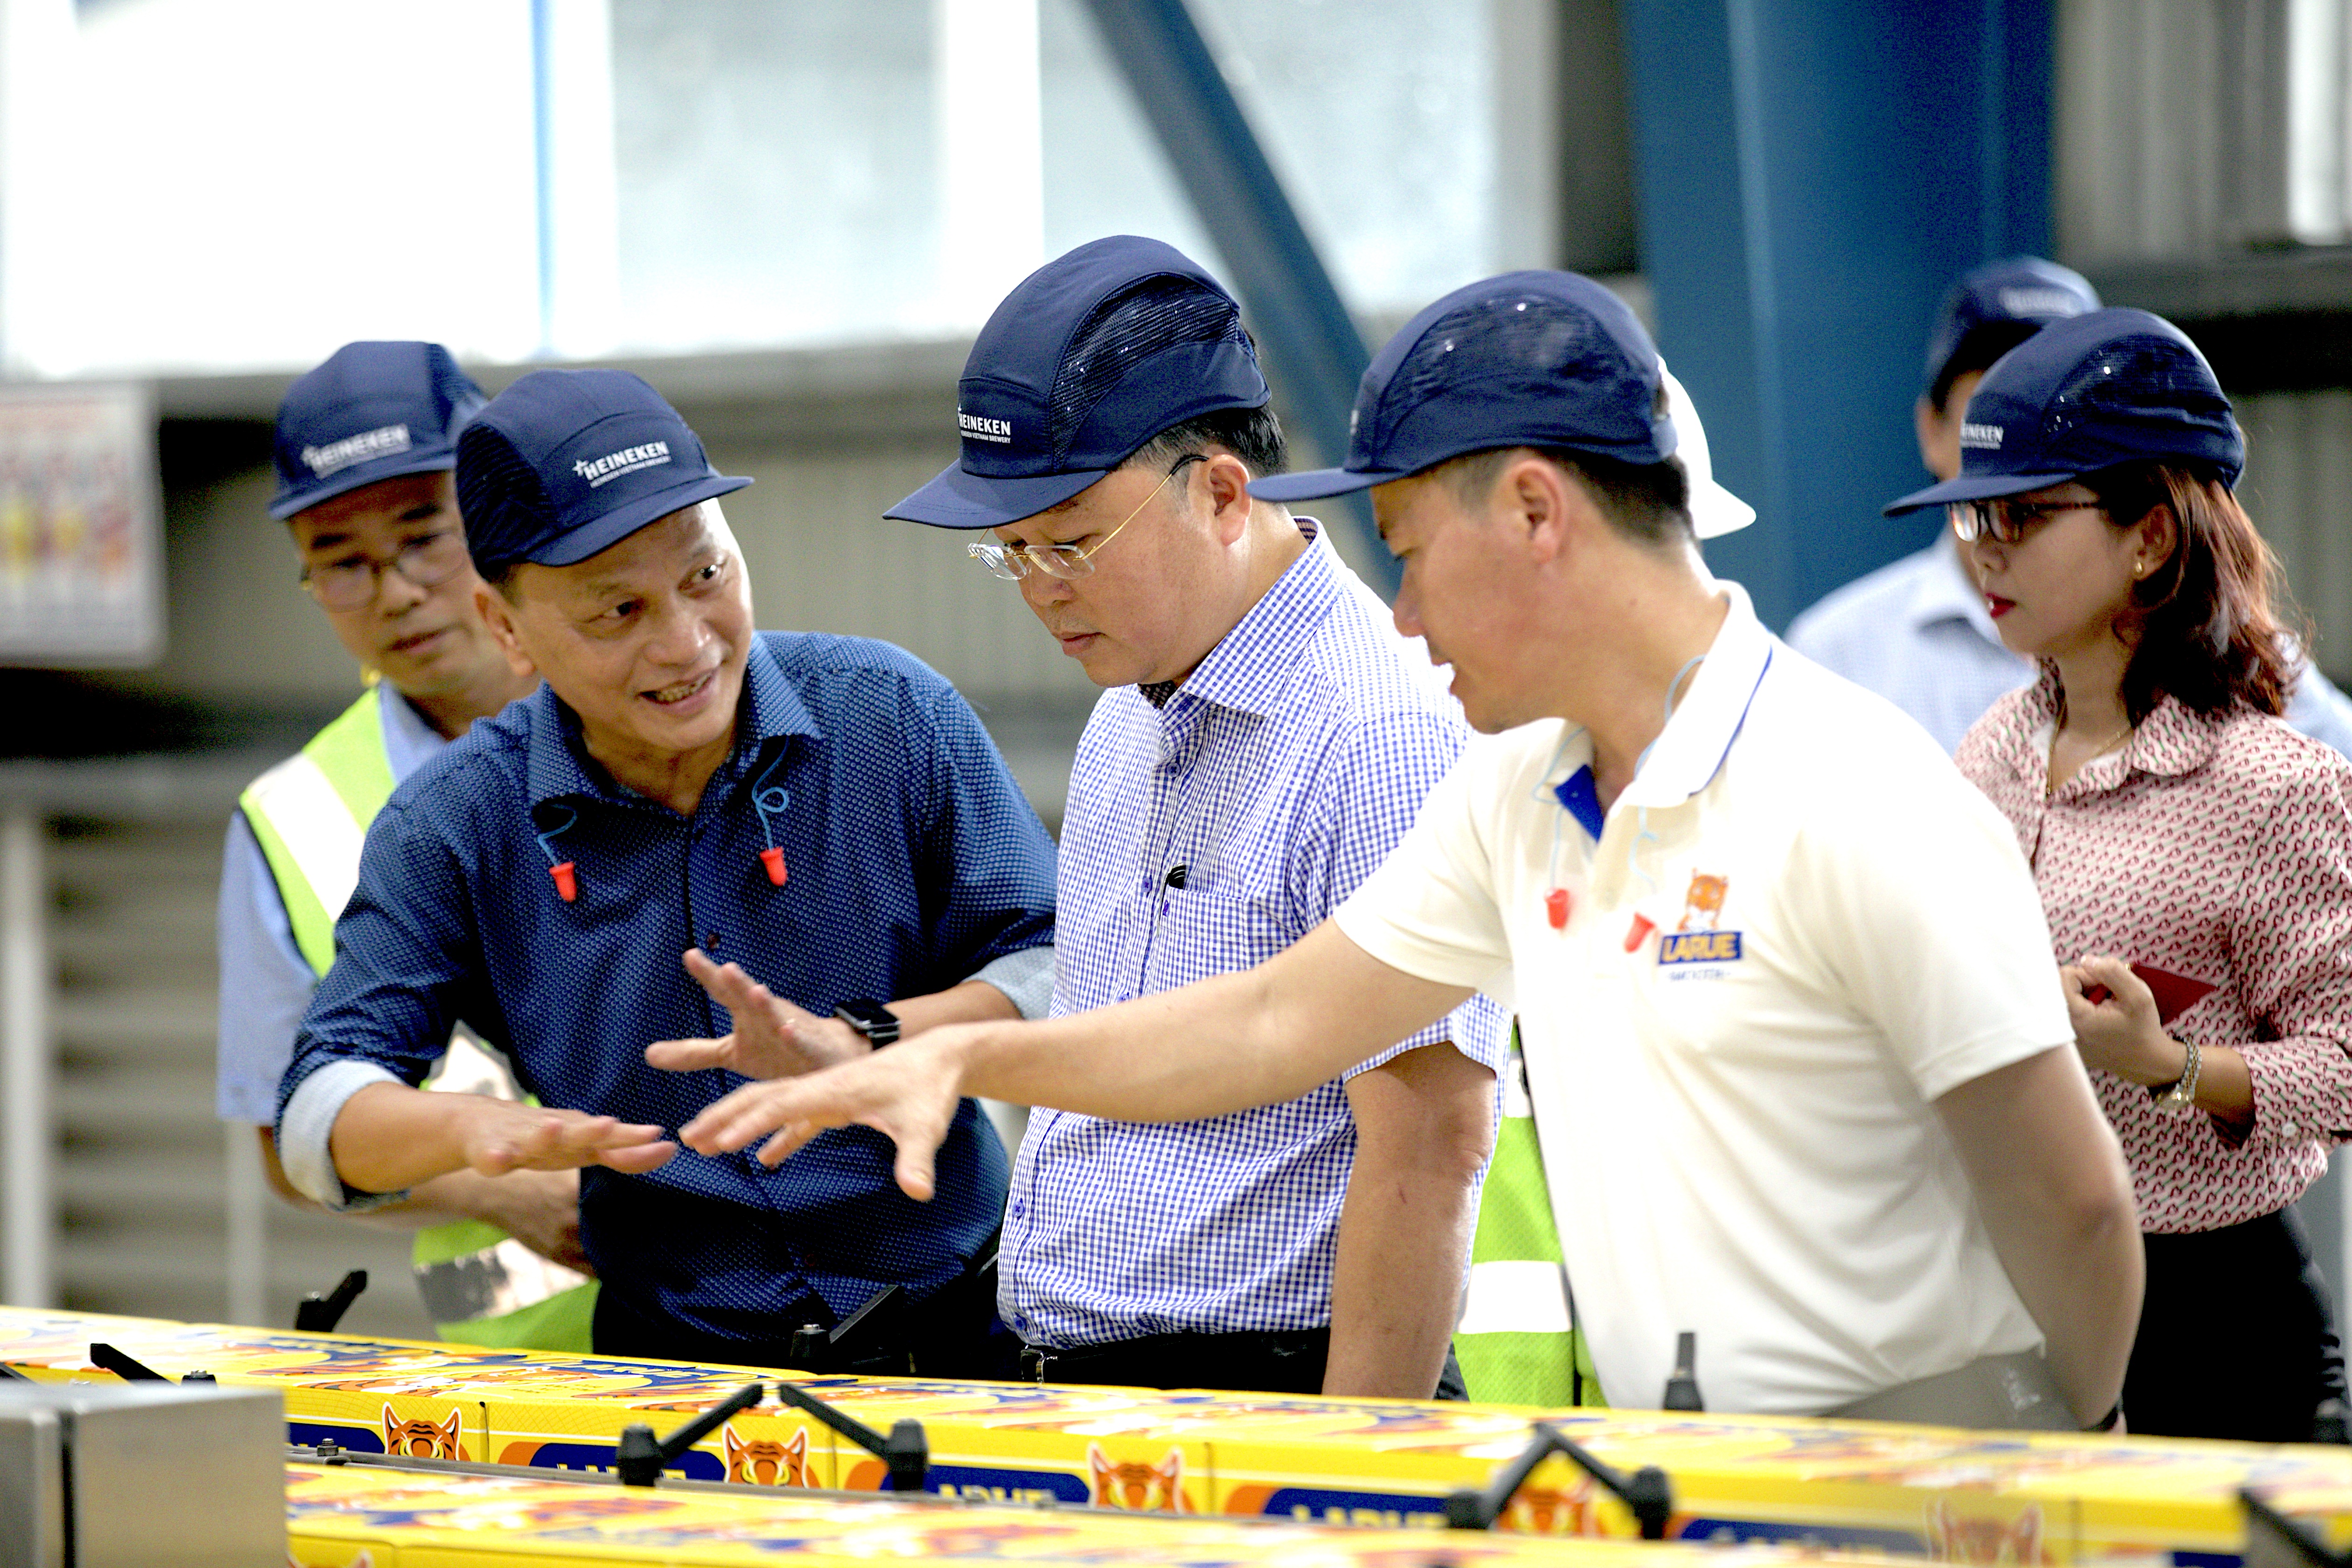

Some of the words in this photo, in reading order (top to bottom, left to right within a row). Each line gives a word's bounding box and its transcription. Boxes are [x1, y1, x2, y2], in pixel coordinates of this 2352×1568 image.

[959, 413, 1011, 435] HEINEKEN
[972, 432, 989, 441] VIETNAM
[989, 435, 1011, 443] BREWERY
[584, 441, 669, 481] HEINEKEN
[1661, 934, 1736, 962] LARUE
